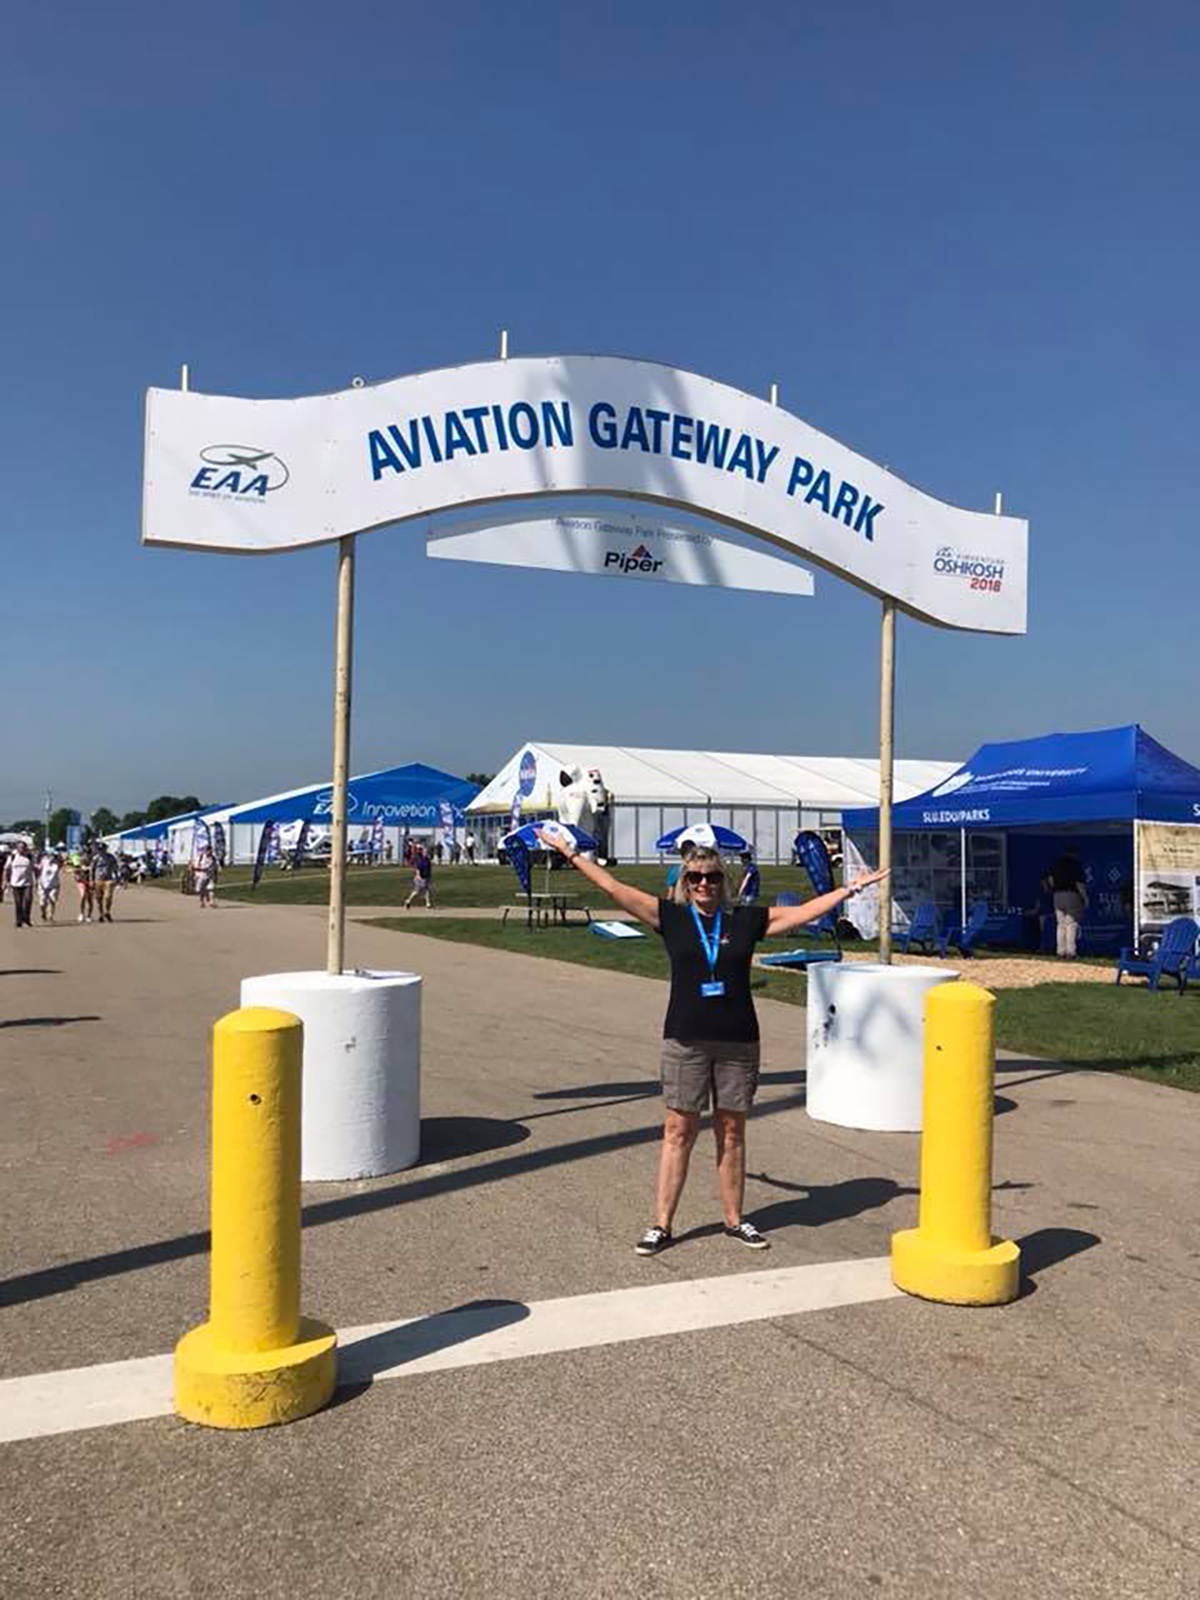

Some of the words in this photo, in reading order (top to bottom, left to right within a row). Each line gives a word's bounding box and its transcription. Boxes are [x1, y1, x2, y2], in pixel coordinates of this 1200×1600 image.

[191, 466, 268, 496] EAA
[368, 401, 574, 481] AVIATION
[589, 402, 780, 483] GATEWAY
[787, 456, 885, 542] PARK
[604, 552, 663, 573] Piper
[934, 558, 1004, 579] OSHKOSH
[970, 577, 1002, 592] 2018
[362, 801, 436, 818] Innovation
